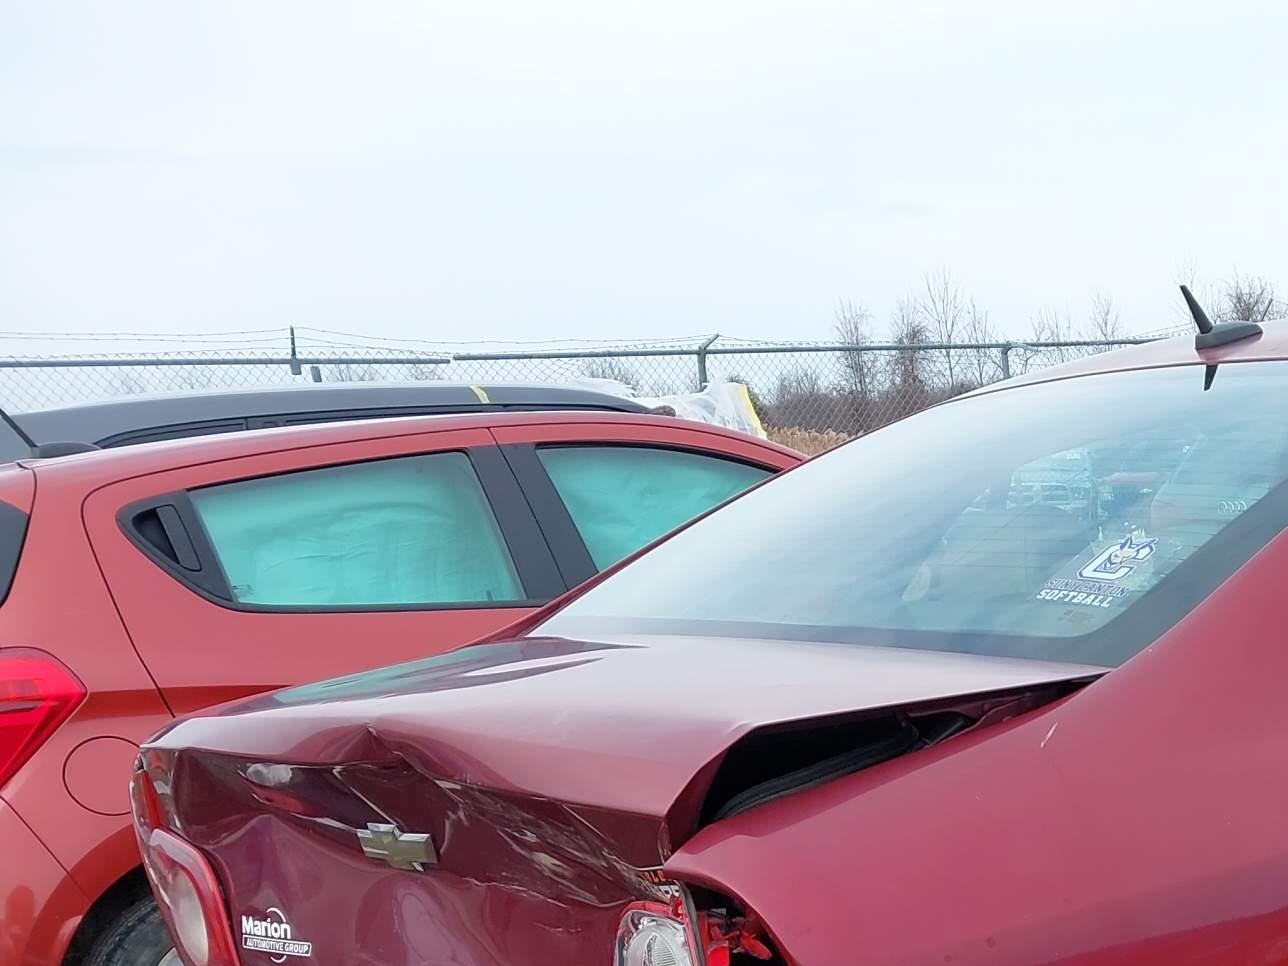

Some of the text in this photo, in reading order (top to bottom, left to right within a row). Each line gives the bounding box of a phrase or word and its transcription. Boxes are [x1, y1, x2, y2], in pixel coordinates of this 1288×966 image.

[1036, 588, 1113, 608] SOFTBALL
[241, 915, 292, 939] Marion
[246, 938, 309, 953] AUTOMOTIVE GROUP
